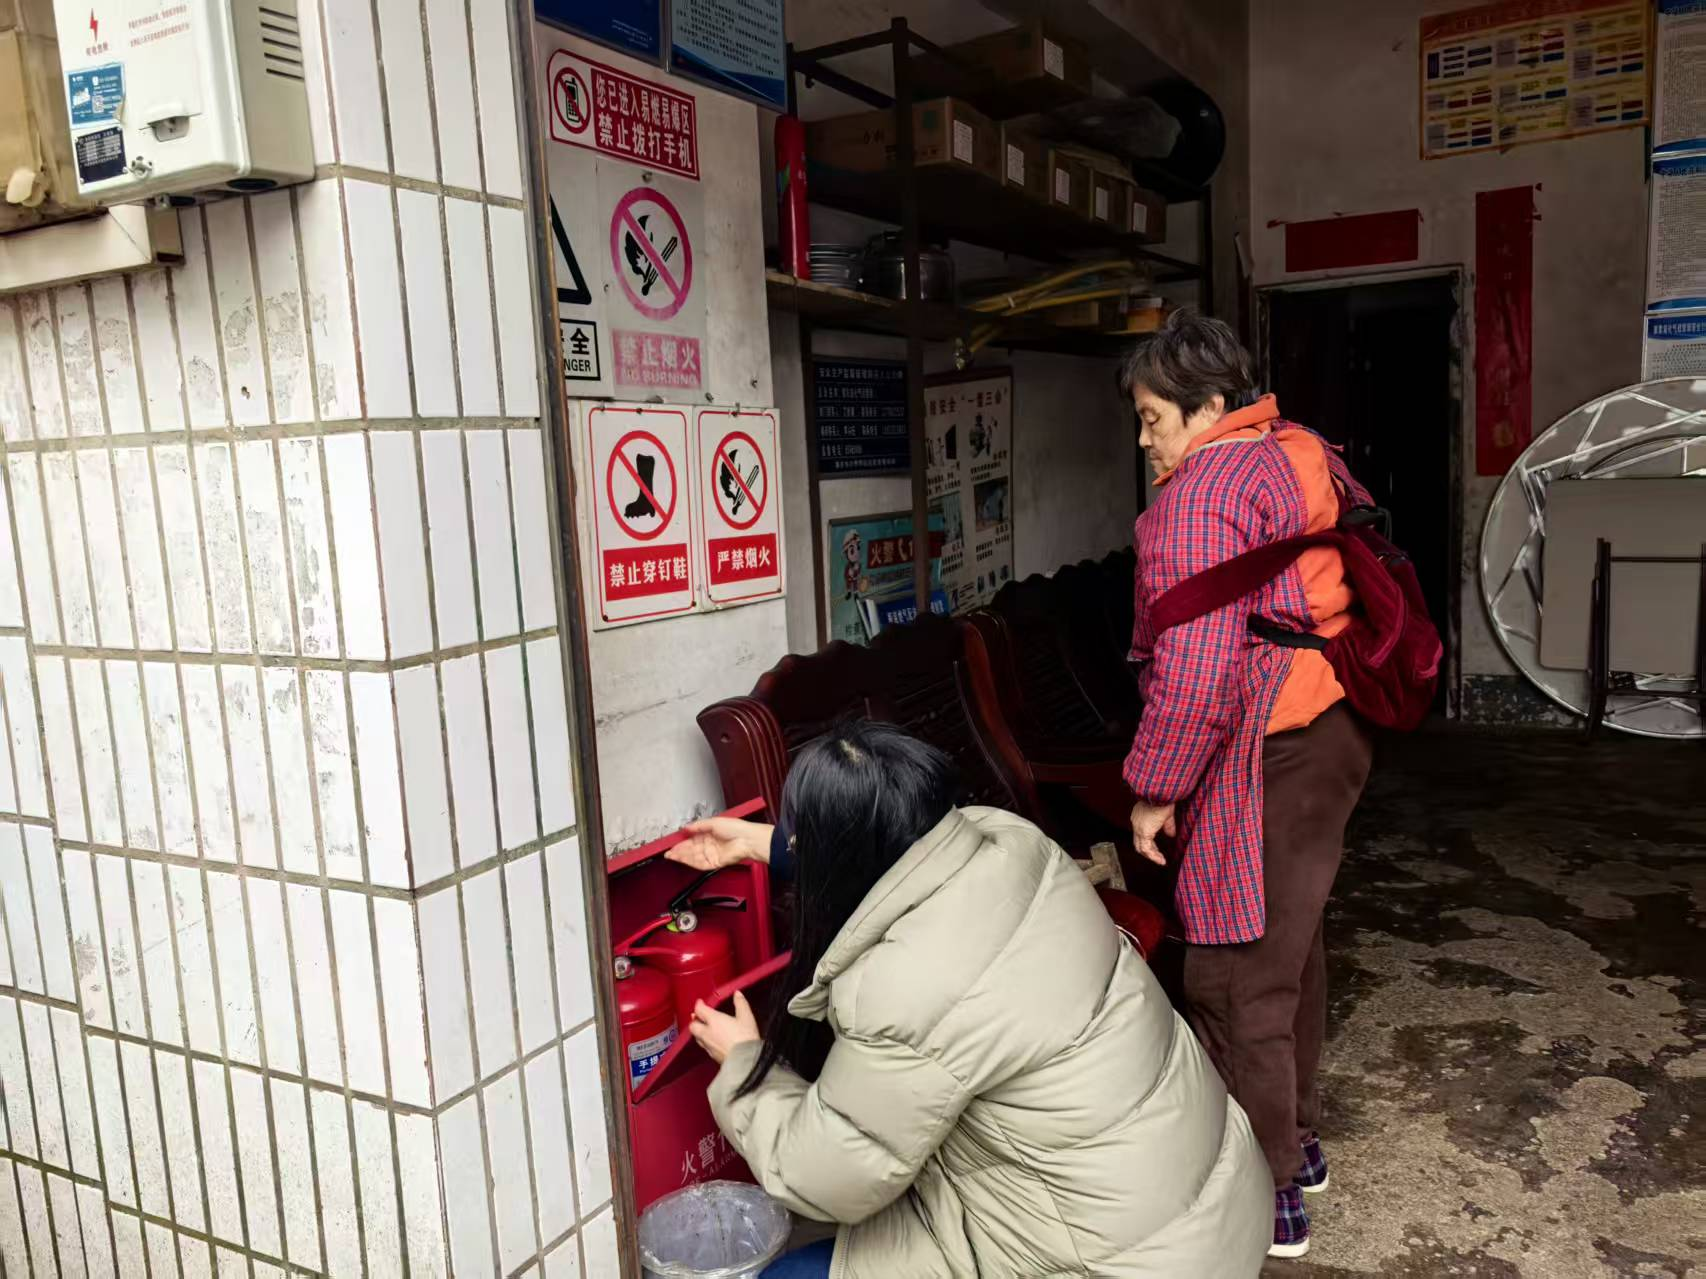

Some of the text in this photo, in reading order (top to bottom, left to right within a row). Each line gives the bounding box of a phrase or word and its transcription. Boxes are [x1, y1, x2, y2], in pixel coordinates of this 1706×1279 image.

[596, 75, 690, 135] 您已进入易燃易爆区
[598, 112, 692, 169] 禁止拨打手机
[560, 327, 590, 355] 全
[619, 335, 697, 370] 禁止烟火
[622, 368, 698, 385] NO BURNING
[609, 556, 688, 588] 禁止穿钉鞋
[716, 545, 772, 574] 严禁烟火
